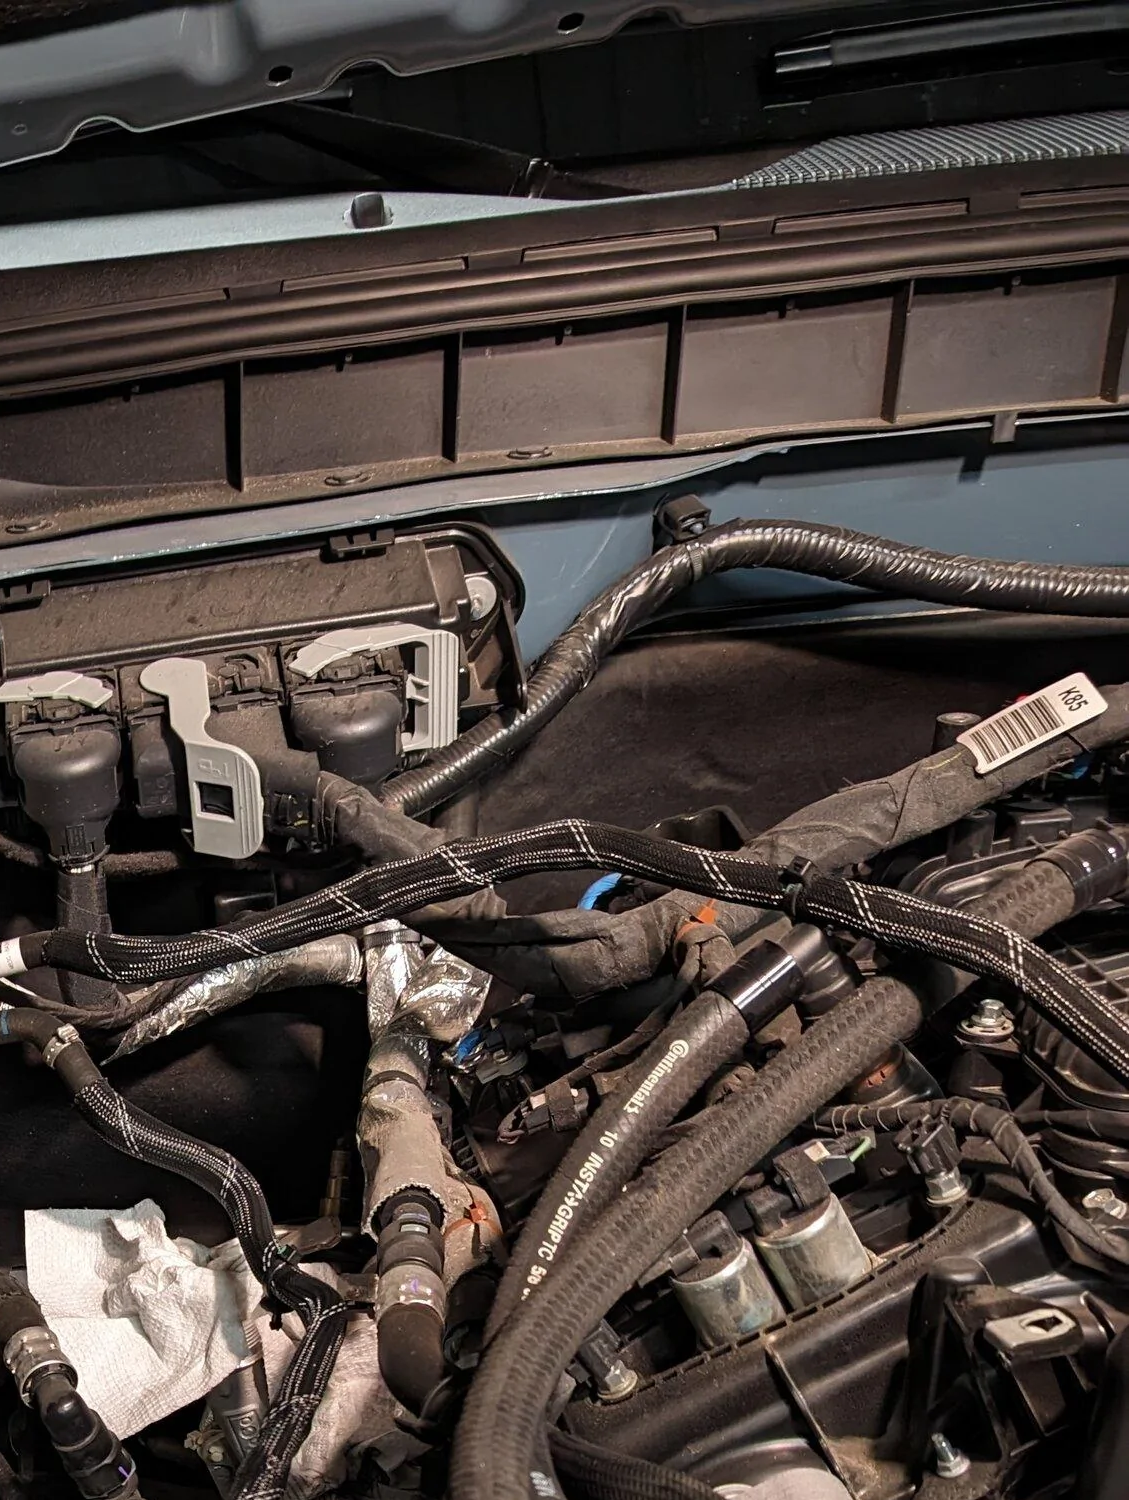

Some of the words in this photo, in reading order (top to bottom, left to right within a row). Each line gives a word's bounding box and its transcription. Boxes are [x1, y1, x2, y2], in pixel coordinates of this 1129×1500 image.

[1058, 686, 1089, 712] K85
[628, 1040, 689, 1109] Continental
[600, 1130, 618, 1148] 10
